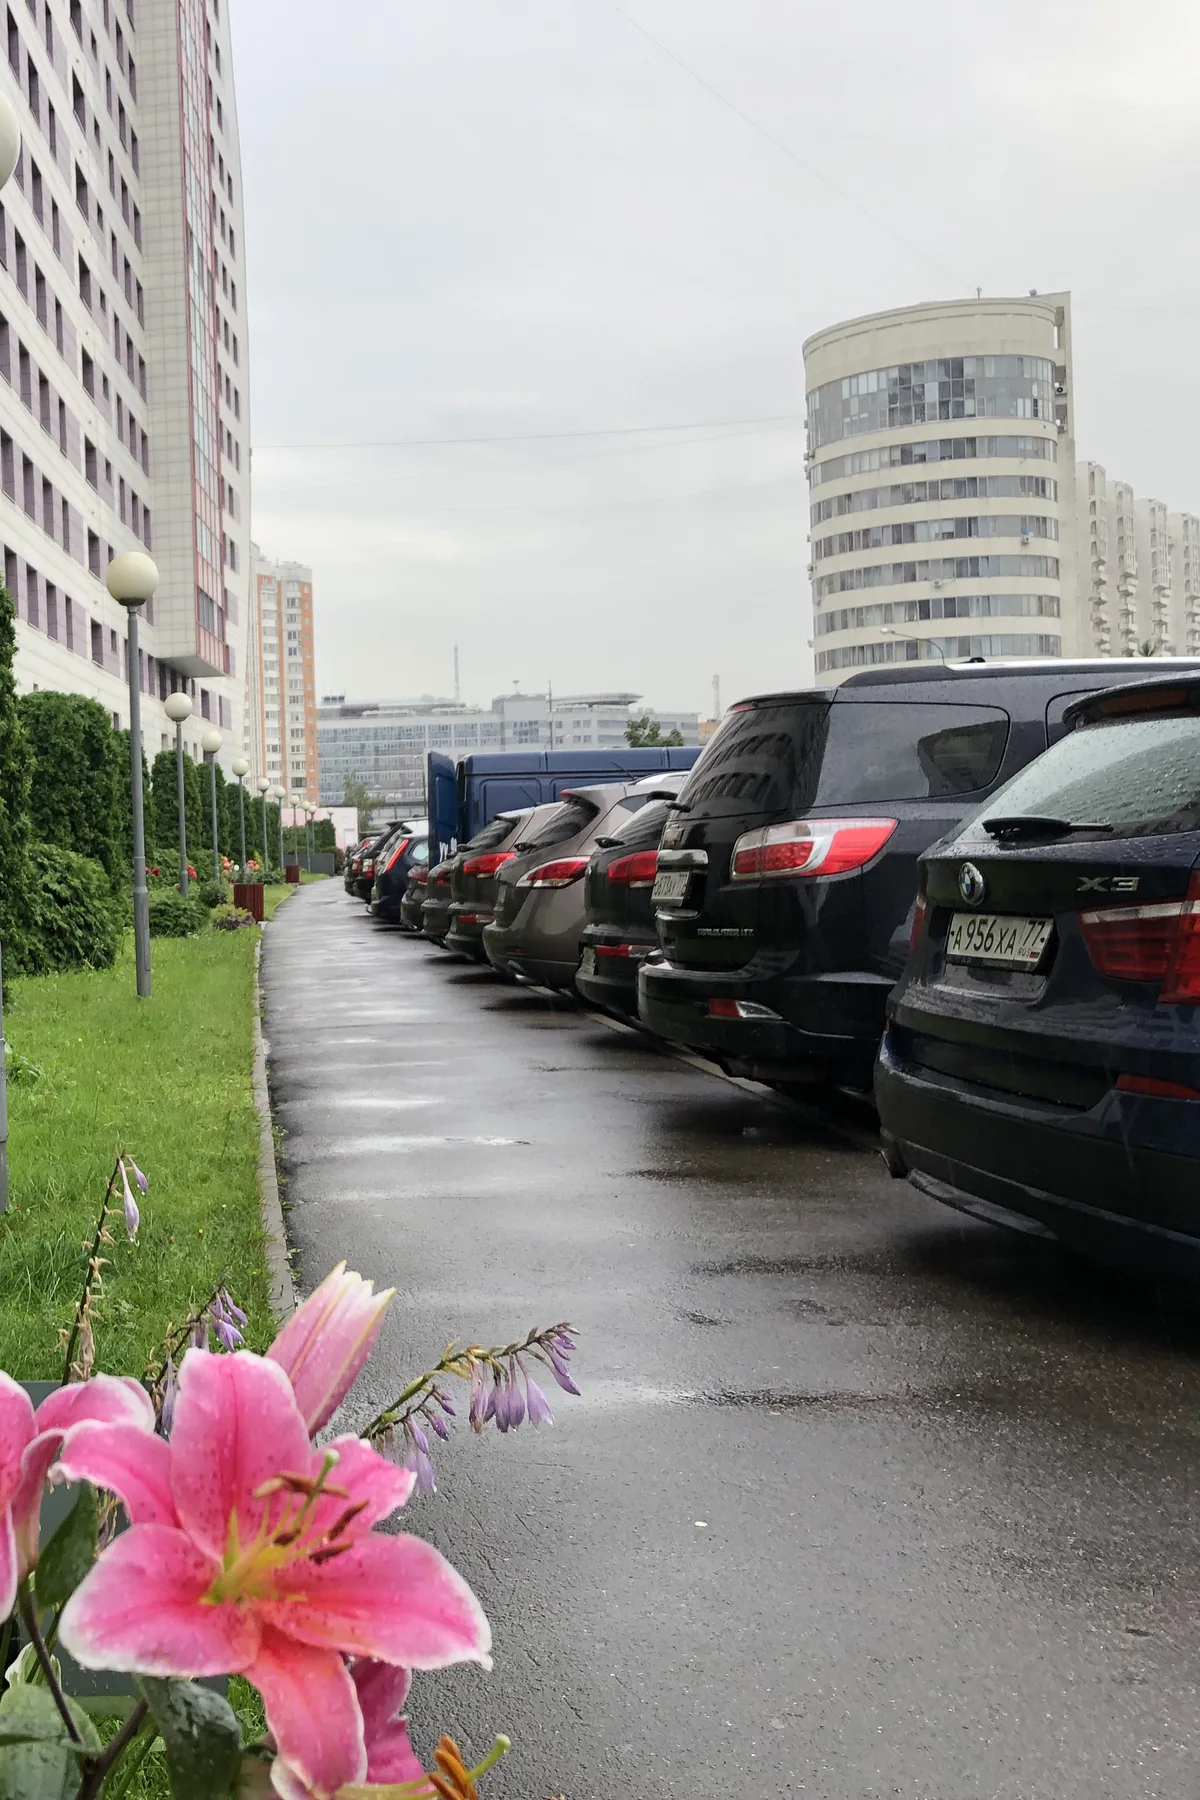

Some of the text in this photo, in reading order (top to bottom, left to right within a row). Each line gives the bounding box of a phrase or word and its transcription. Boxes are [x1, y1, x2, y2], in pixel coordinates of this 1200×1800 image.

[1076, 876, 1140, 892] X3
[1023, 920, 1046, 947] 77
[1016, 947, 1032, 957] RUS
